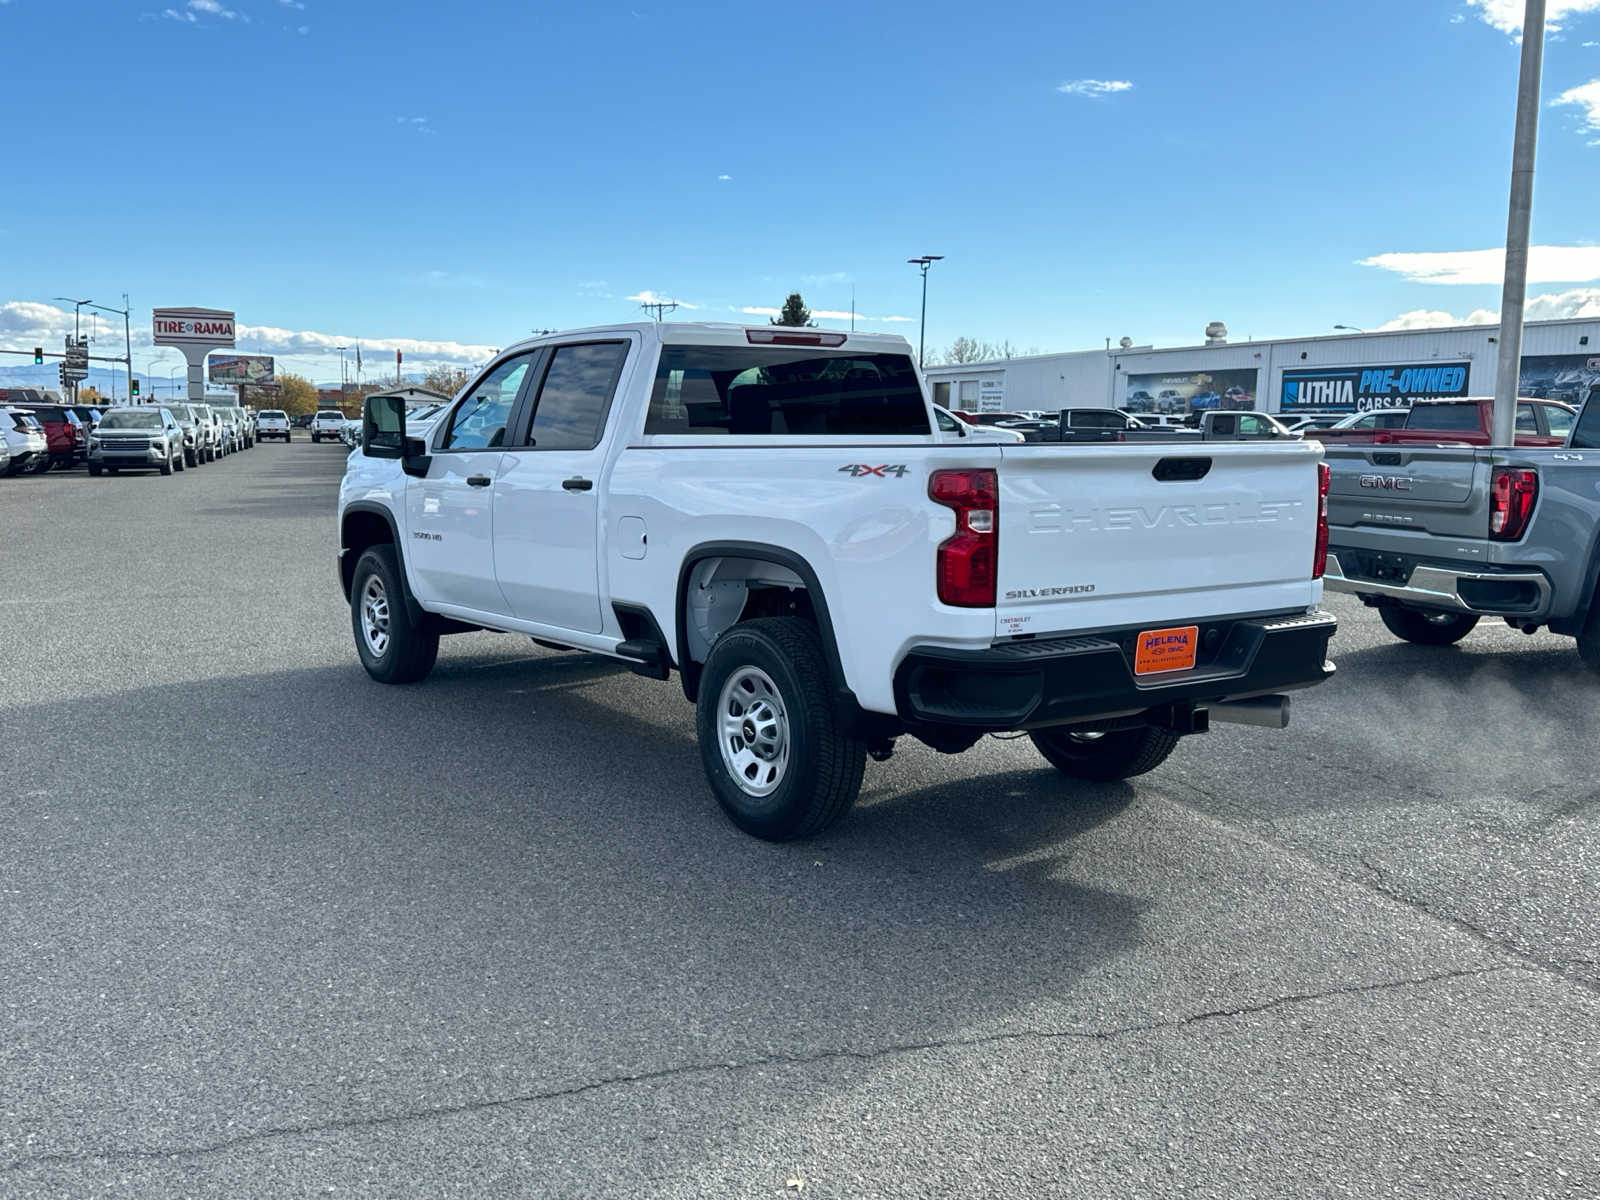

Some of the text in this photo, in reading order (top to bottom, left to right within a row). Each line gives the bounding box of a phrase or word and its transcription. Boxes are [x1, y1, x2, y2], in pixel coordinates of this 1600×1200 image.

[155, 320, 232, 335] TIRE RAMA
[1358, 367, 1466, 393] PRE-OWNED
[1298, 380, 1354, 404] LITHIA
[1357, 397, 1391, 413] CARS
[1360, 474, 1413, 491] GMC
[1029, 500, 1303, 534] CHEVROLET
[1005, 584, 1096, 599] SILVERADO
[1145, 634, 1188, 649] HELENA
